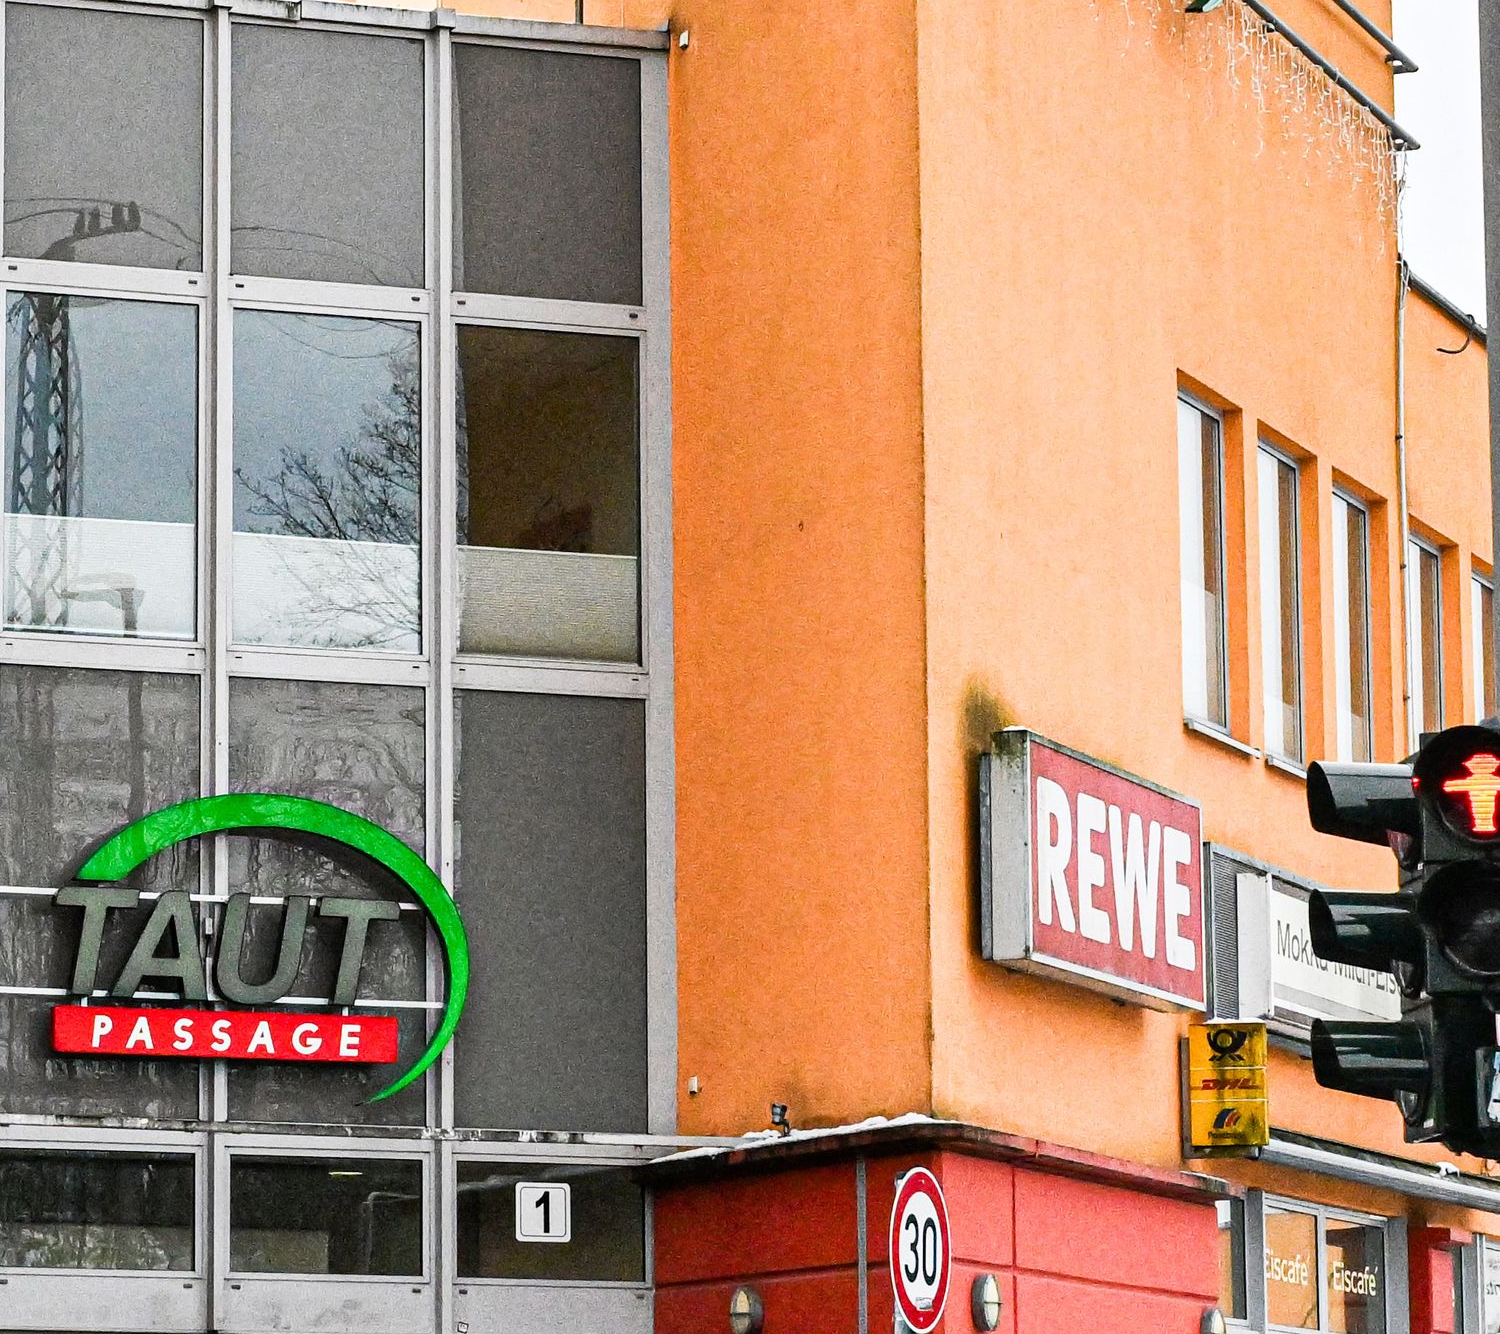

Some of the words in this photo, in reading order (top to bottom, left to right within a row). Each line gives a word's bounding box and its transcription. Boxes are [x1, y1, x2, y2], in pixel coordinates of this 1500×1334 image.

[1036, 774, 1197, 972] REWE
[54, 880, 401, 1007] TAUT
[90, 1014, 362, 1058] PASSAGE
[533, 1190, 551, 1234] 1
[904, 1213, 938, 1286] 30
